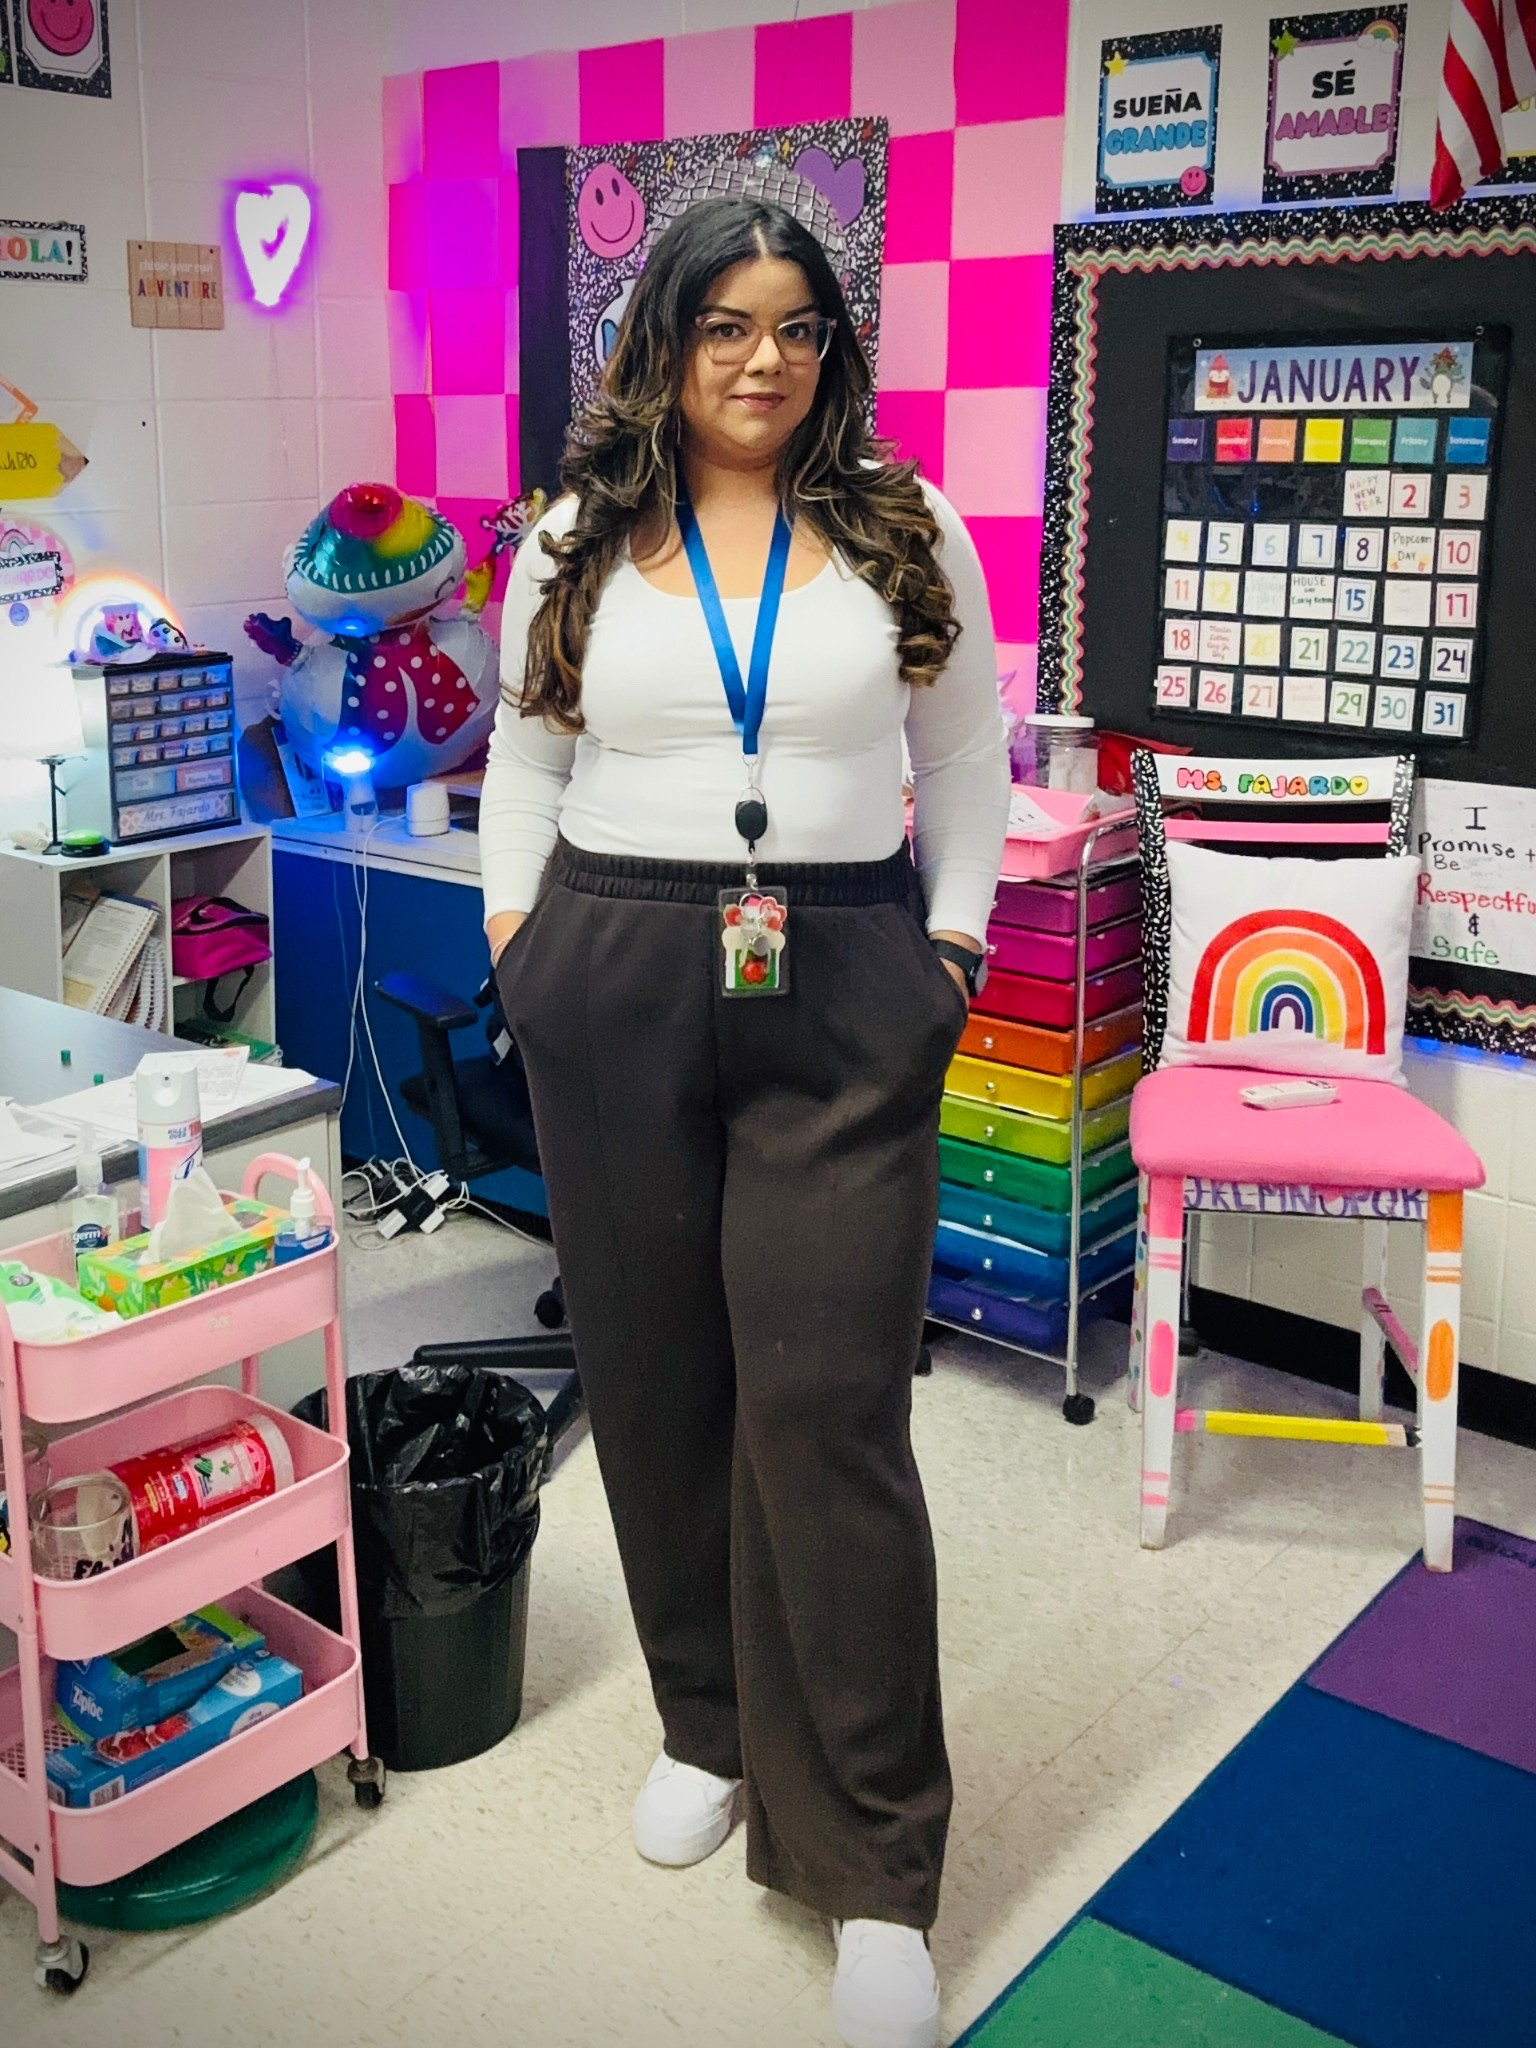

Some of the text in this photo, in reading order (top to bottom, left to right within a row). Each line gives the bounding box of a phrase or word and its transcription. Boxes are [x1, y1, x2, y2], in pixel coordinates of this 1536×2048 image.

[1312, 60, 1356, 98] SÉ
[1113, 88, 1202, 119] SUEÑA
[1275, 103, 1391, 141] AMABLE
[1105, 120, 1207, 155] GRANDE
[1238, 356, 1420, 403] JANUARY
[1403, 485, 1416, 508] 2
[1459, 485, 1470, 508] 3
[1219, 533, 1230, 554] 5
[1264, 535, 1275, 556] 6
[1312, 535, 1323, 557] 7
[1357, 538, 1369, 561] 8
[1448, 541, 1470, 564] 10
[1175, 579, 1189, 600] 11
[1293, 576, 1326, 587] HOUSE
[1346, 589, 1366, 611] 15
[1447, 594, 1467, 617] 17
[1173, 629, 1190, 650] 18
[1299, 638, 1319, 660] 21
[1342, 640, 1369, 664] 22
[1388, 645, 1414, 668] 23
[1437, 648, 1465, 672] 24
[1163, 676, 1185, 697] 25
[1205, 681, 1226, 703] 26
[1249, 685, 1272, 708] 27
[1337, 692, 1362, 716] 29
[1381, 696, 1406, 719] 30
[1434, 703, 1454, 725] 31
[1177, 768, 1369, 798] MS. FAJARDO
[169, 801, 211, 818] Fajardo
[1463, 806, 1488, 830] I
[1418, 831, 1516, 858] Promise
[1433, 854, 1462, 871] Be
[1417, 872, 1536, 914] Respectfu
[1431, 936, 1500, 965] Safe
[74, 1686, 103, 1721] Ziploc
